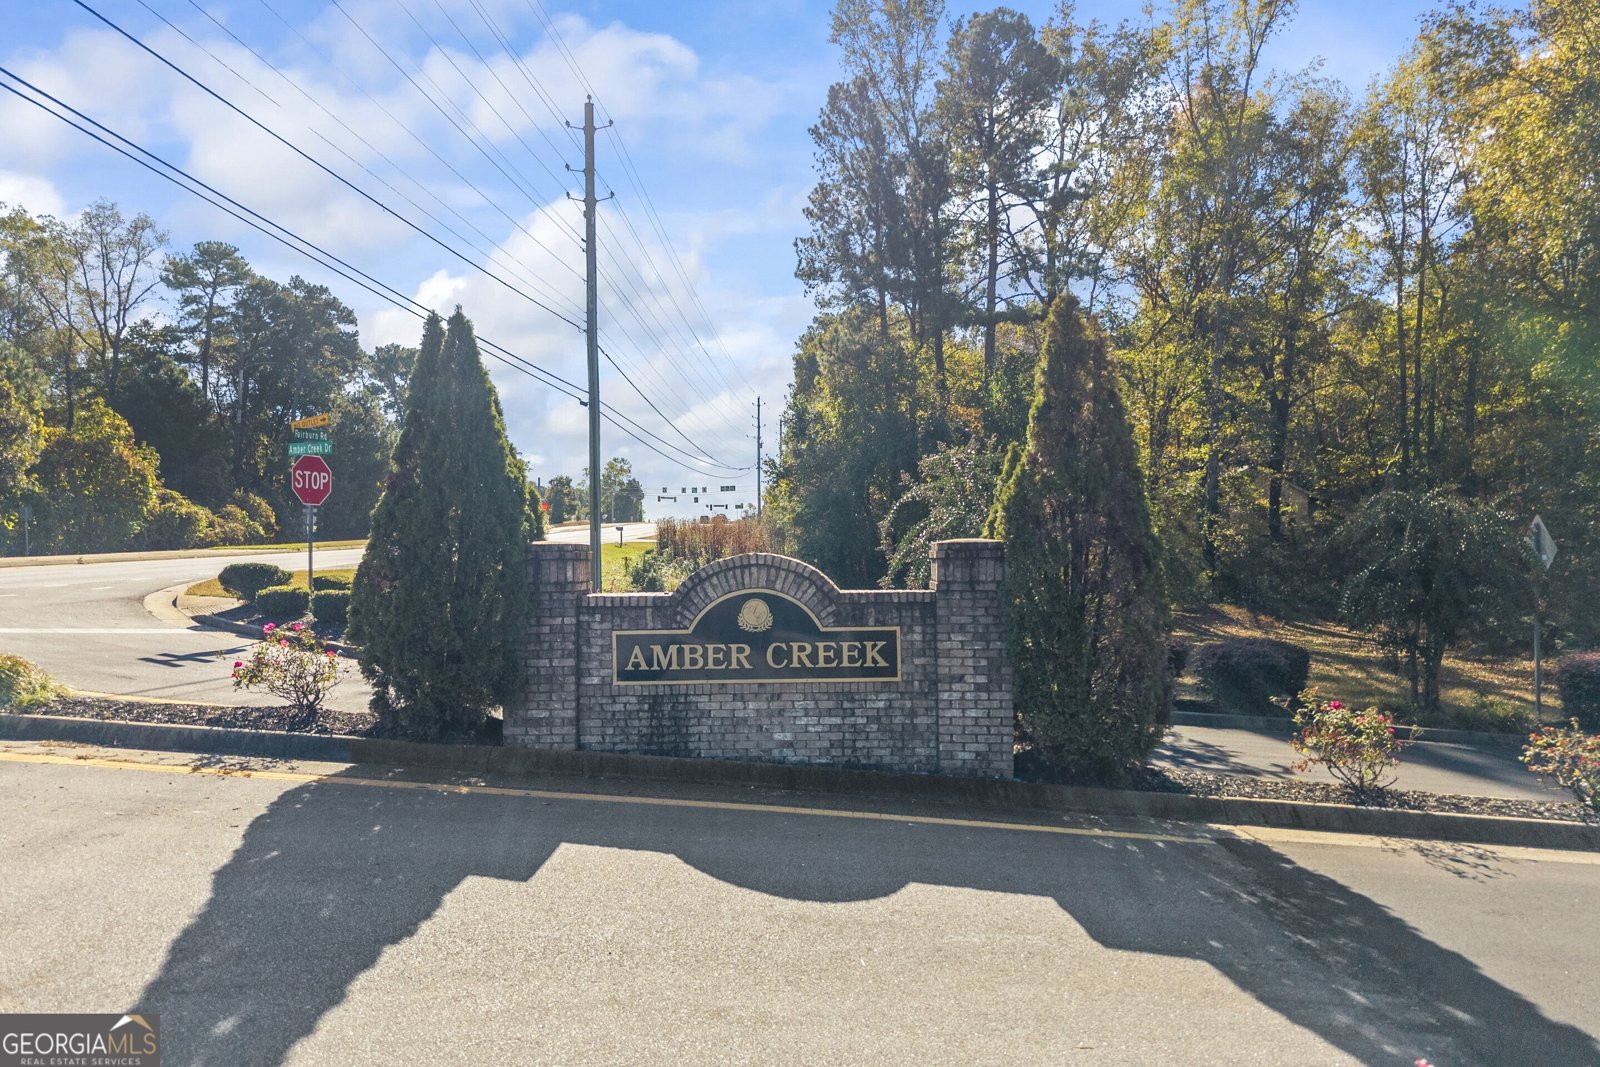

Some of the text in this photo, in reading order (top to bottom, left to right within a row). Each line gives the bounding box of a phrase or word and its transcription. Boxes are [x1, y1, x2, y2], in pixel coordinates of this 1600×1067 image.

[302, 417, 319, 428] OUTLET
[295, 430, 327, 441] Fairburn Rd
[289, 443, 331, 454] Amber Creek Dr
[294, 470, 329, 490] STOP
[625, 641, 890, 671] AMBER CREEK
